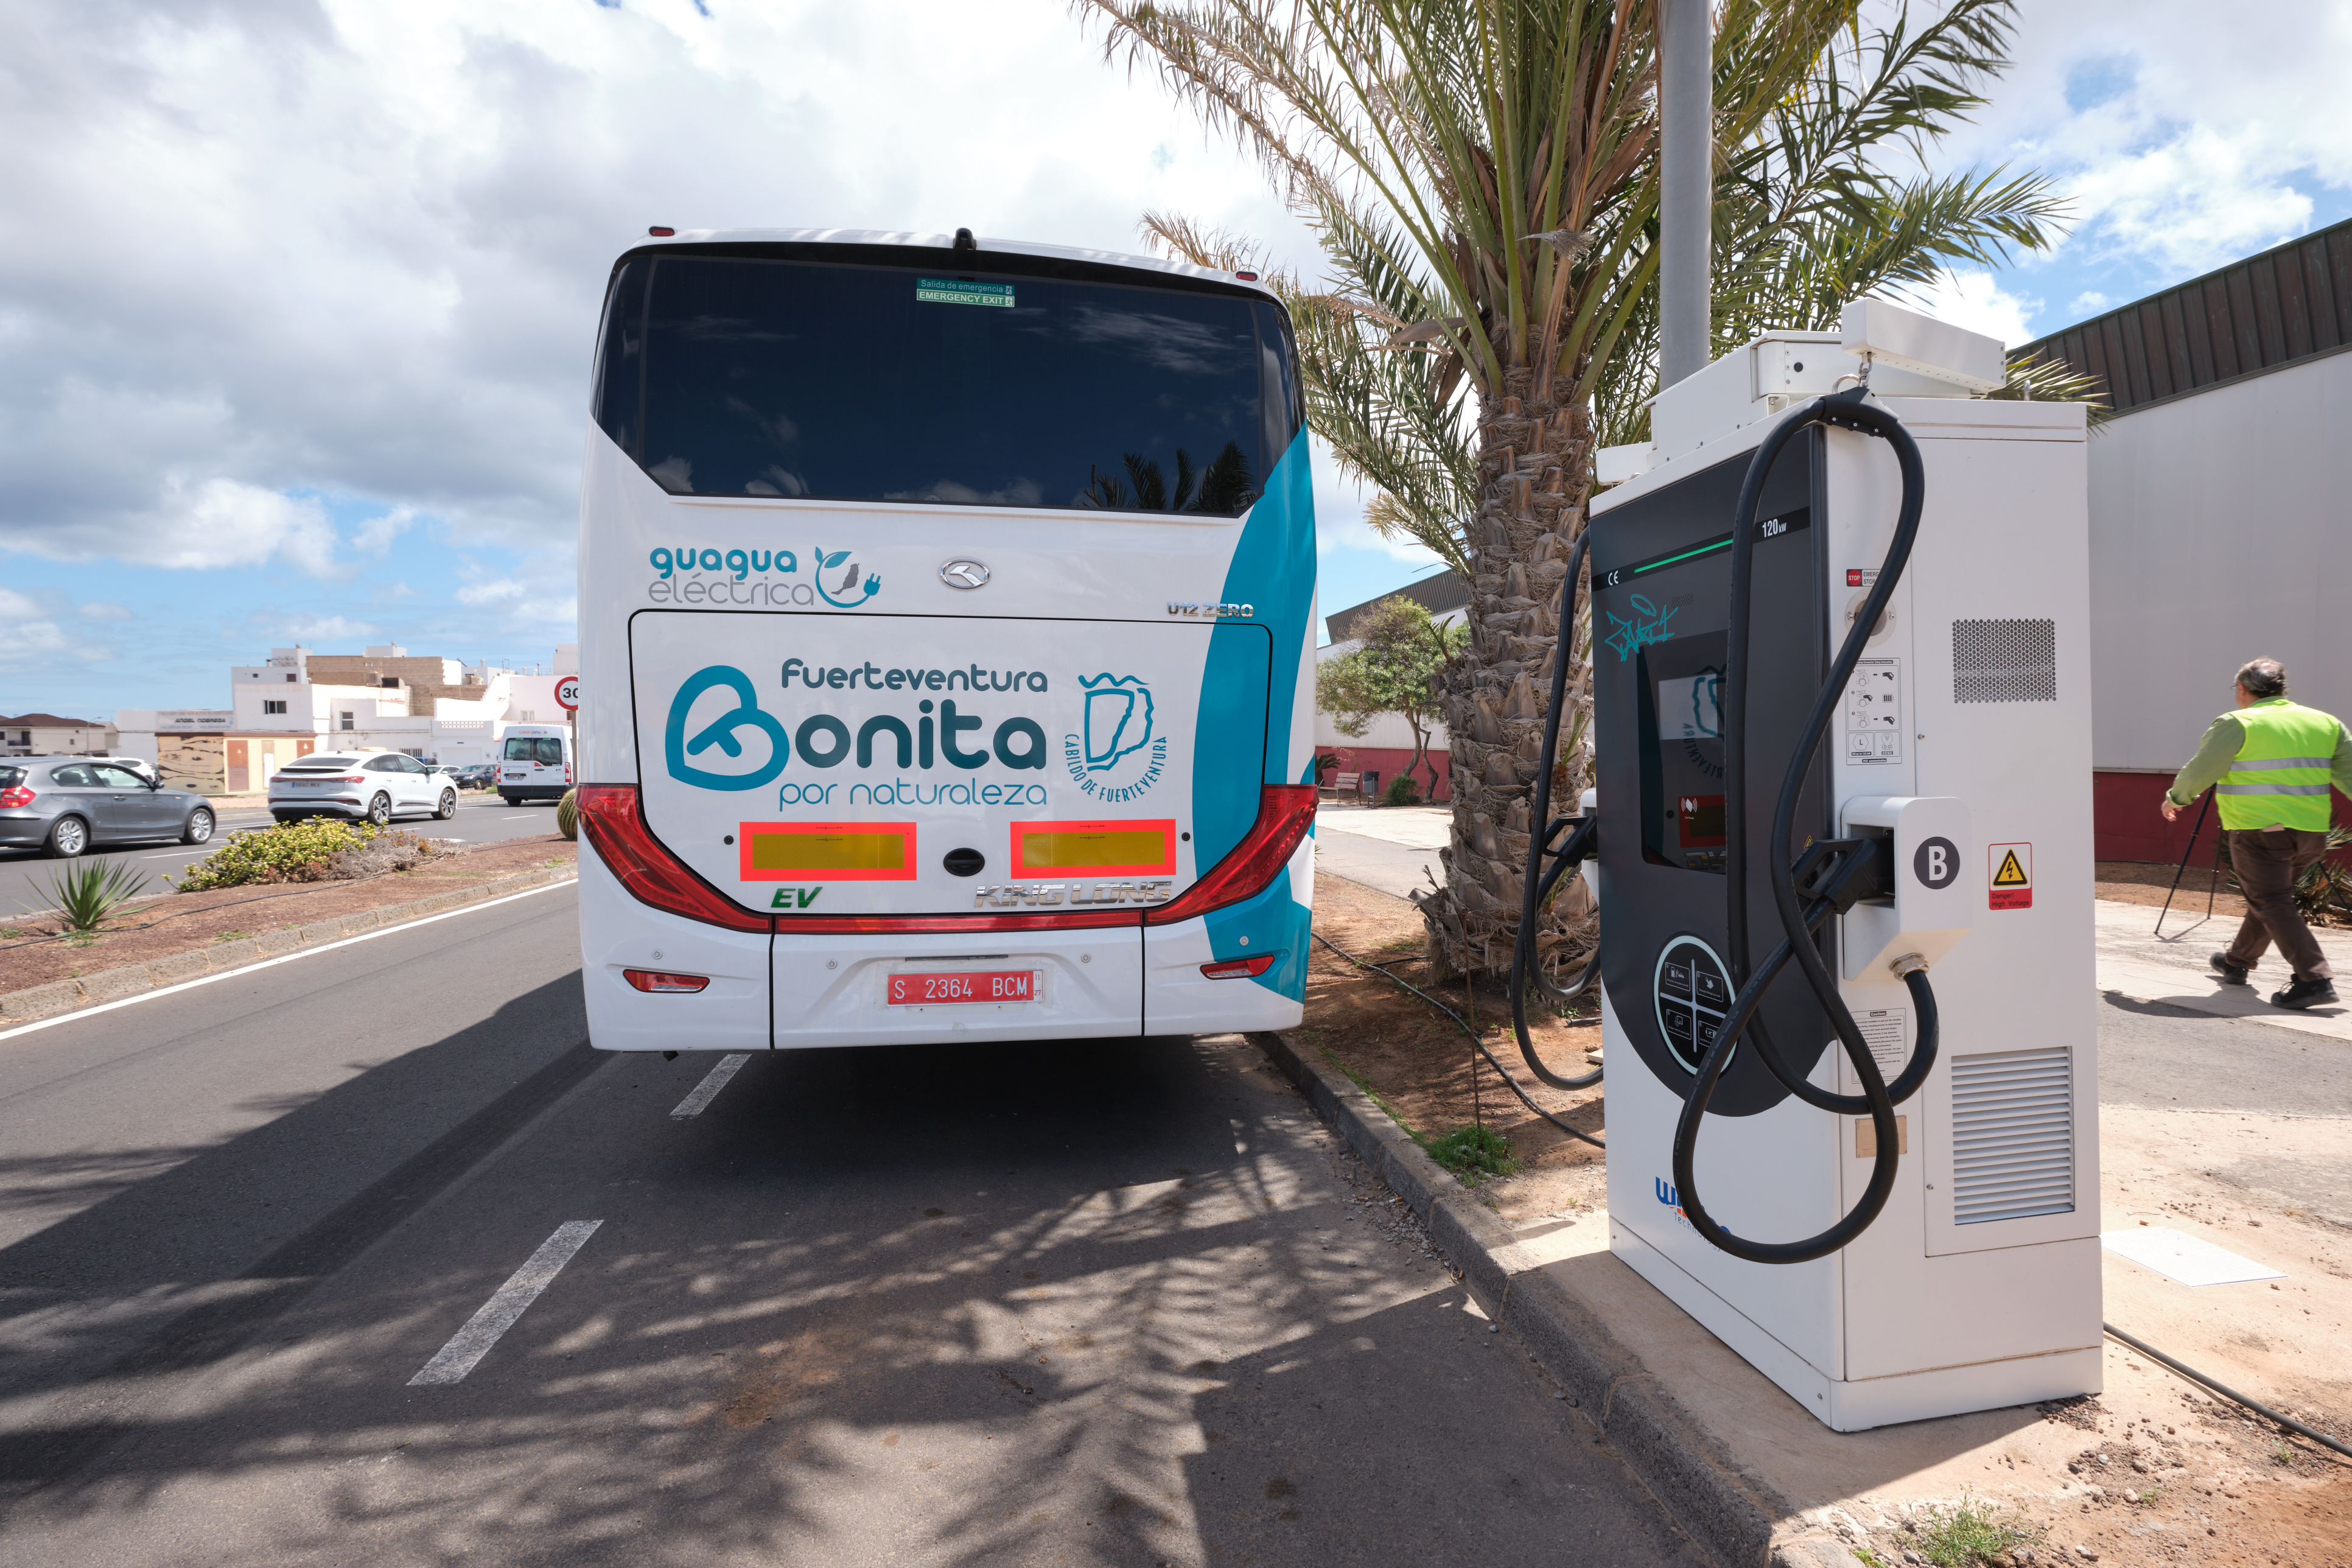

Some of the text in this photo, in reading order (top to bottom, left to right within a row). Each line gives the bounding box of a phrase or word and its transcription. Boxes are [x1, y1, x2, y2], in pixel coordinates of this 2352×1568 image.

[921, 280, 945, 289] Salida
[959, 284, 1003, 293] emergencia
[919, 292, 1004, 304] EMERGENCY EXIT
[1762, 519, 1787, 537] 120 kW
[649, 547, 797, 581] guagua
[648, 572, 814, 606] eléctrica
[1167, 601, 1254, 618] U12 ZERO
[563, 688, 578, 699] 30
[1065, 734, 1167, 802] CABILDO DE FUERTEVENTURA
[779, 777, 1048, 812] por naturaleza
[1928, 845, 1947, 881] B
[771, 887, 823, 908] EV
[974, 881, 1172, 908] KING LONG
[894, 977, 1027, 999] S 2364 BCM
